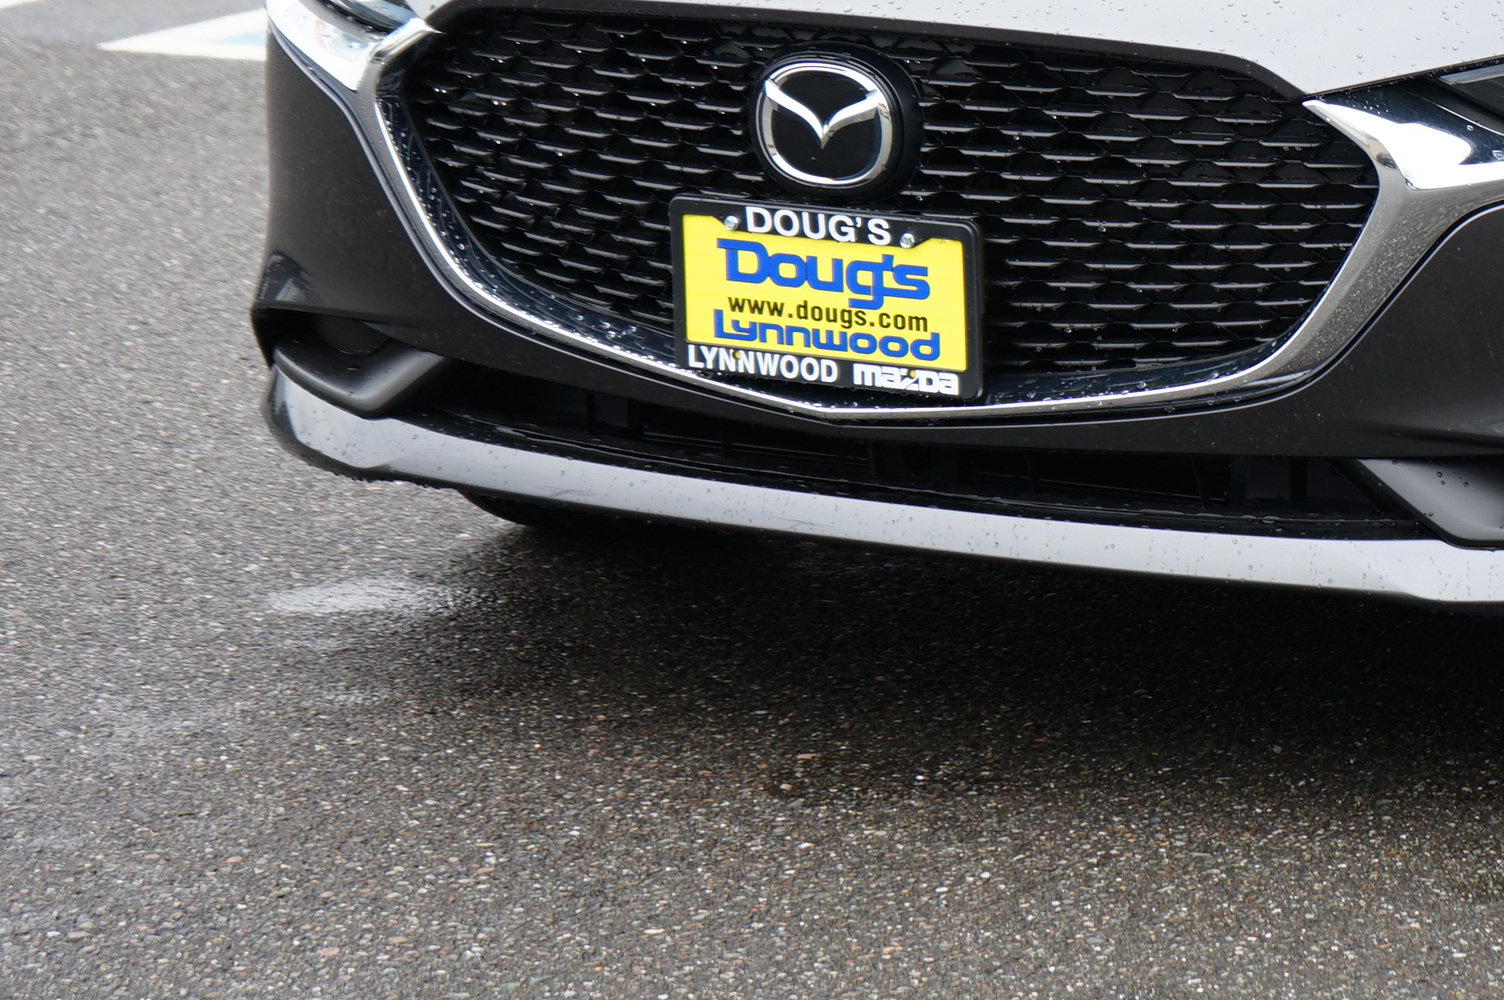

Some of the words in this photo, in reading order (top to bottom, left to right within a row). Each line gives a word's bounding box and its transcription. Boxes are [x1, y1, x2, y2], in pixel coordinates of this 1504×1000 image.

[745, 206, 892, 245] DOUG'S
[728, 297, 928, 332] www.dougs.com
[713, 309, 941, 361] Lynnwood
[687, 344, 838, 383] LYNNWOOD
